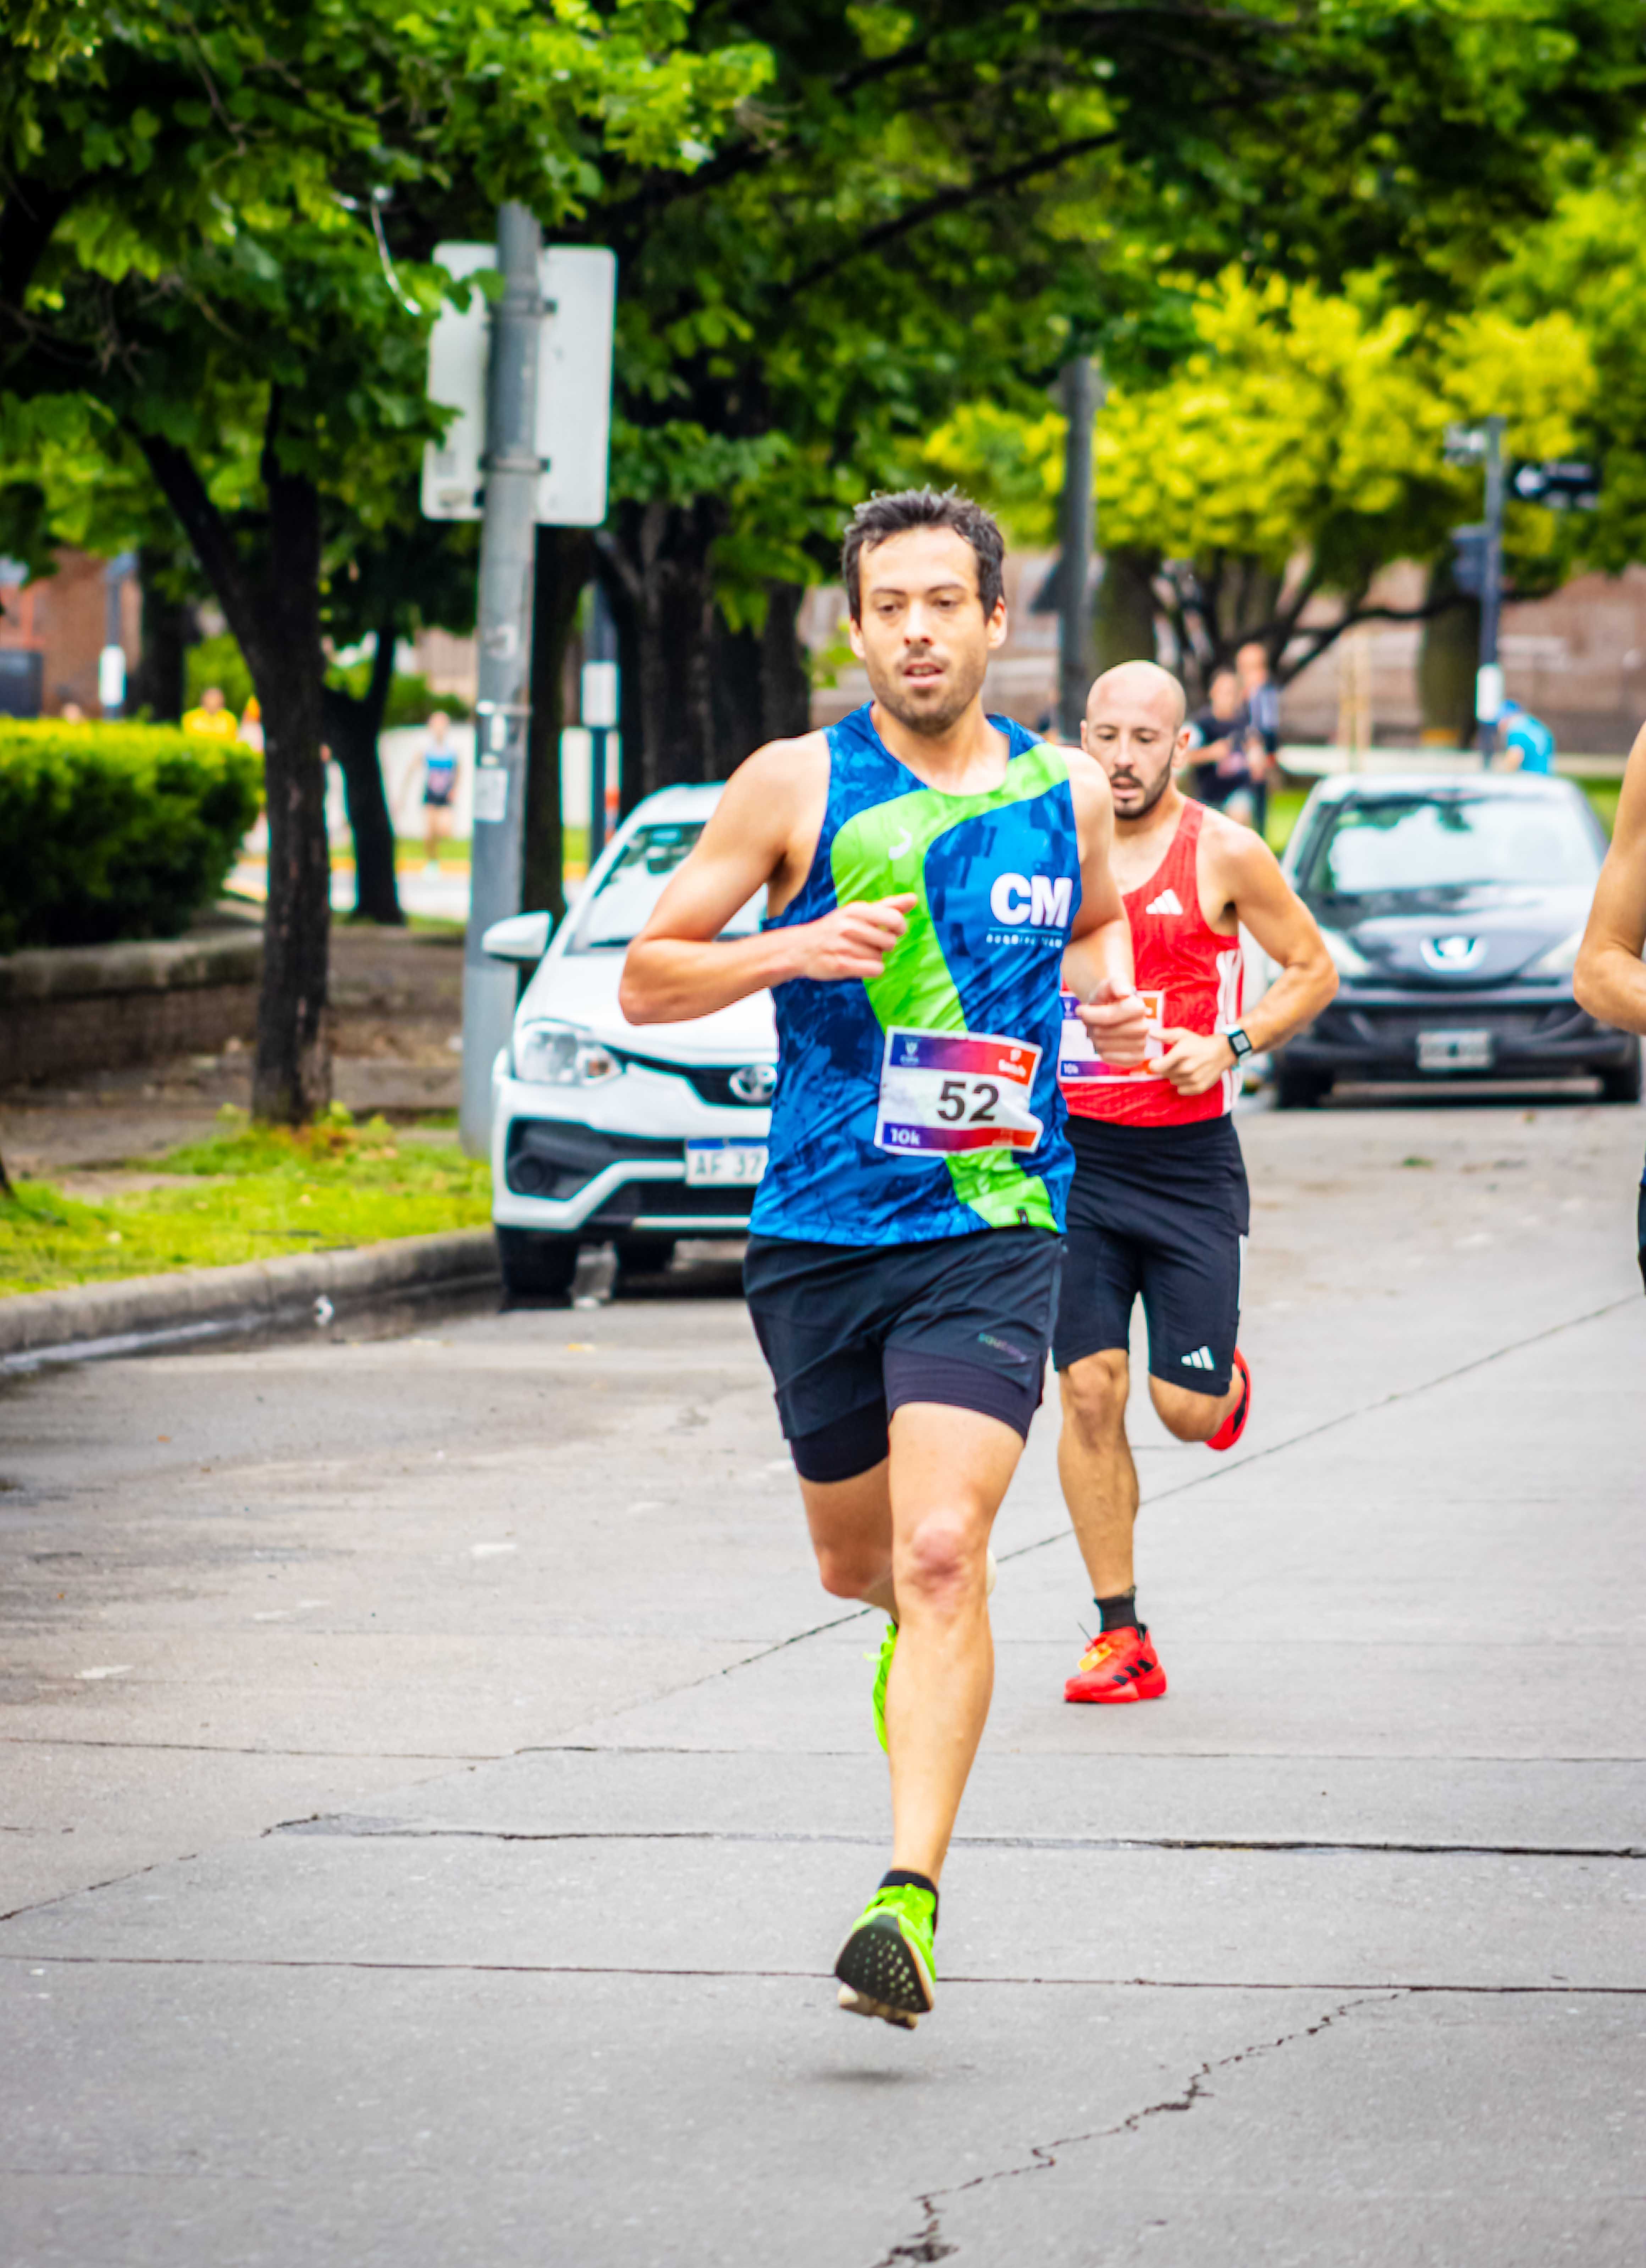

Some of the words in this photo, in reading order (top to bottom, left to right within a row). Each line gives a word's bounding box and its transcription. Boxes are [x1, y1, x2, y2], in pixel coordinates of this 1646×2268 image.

[990, 872, 1073, 928] CM
[937, 1081, 999, 1122] 52
[696, 1154, 722, 1175] AF
